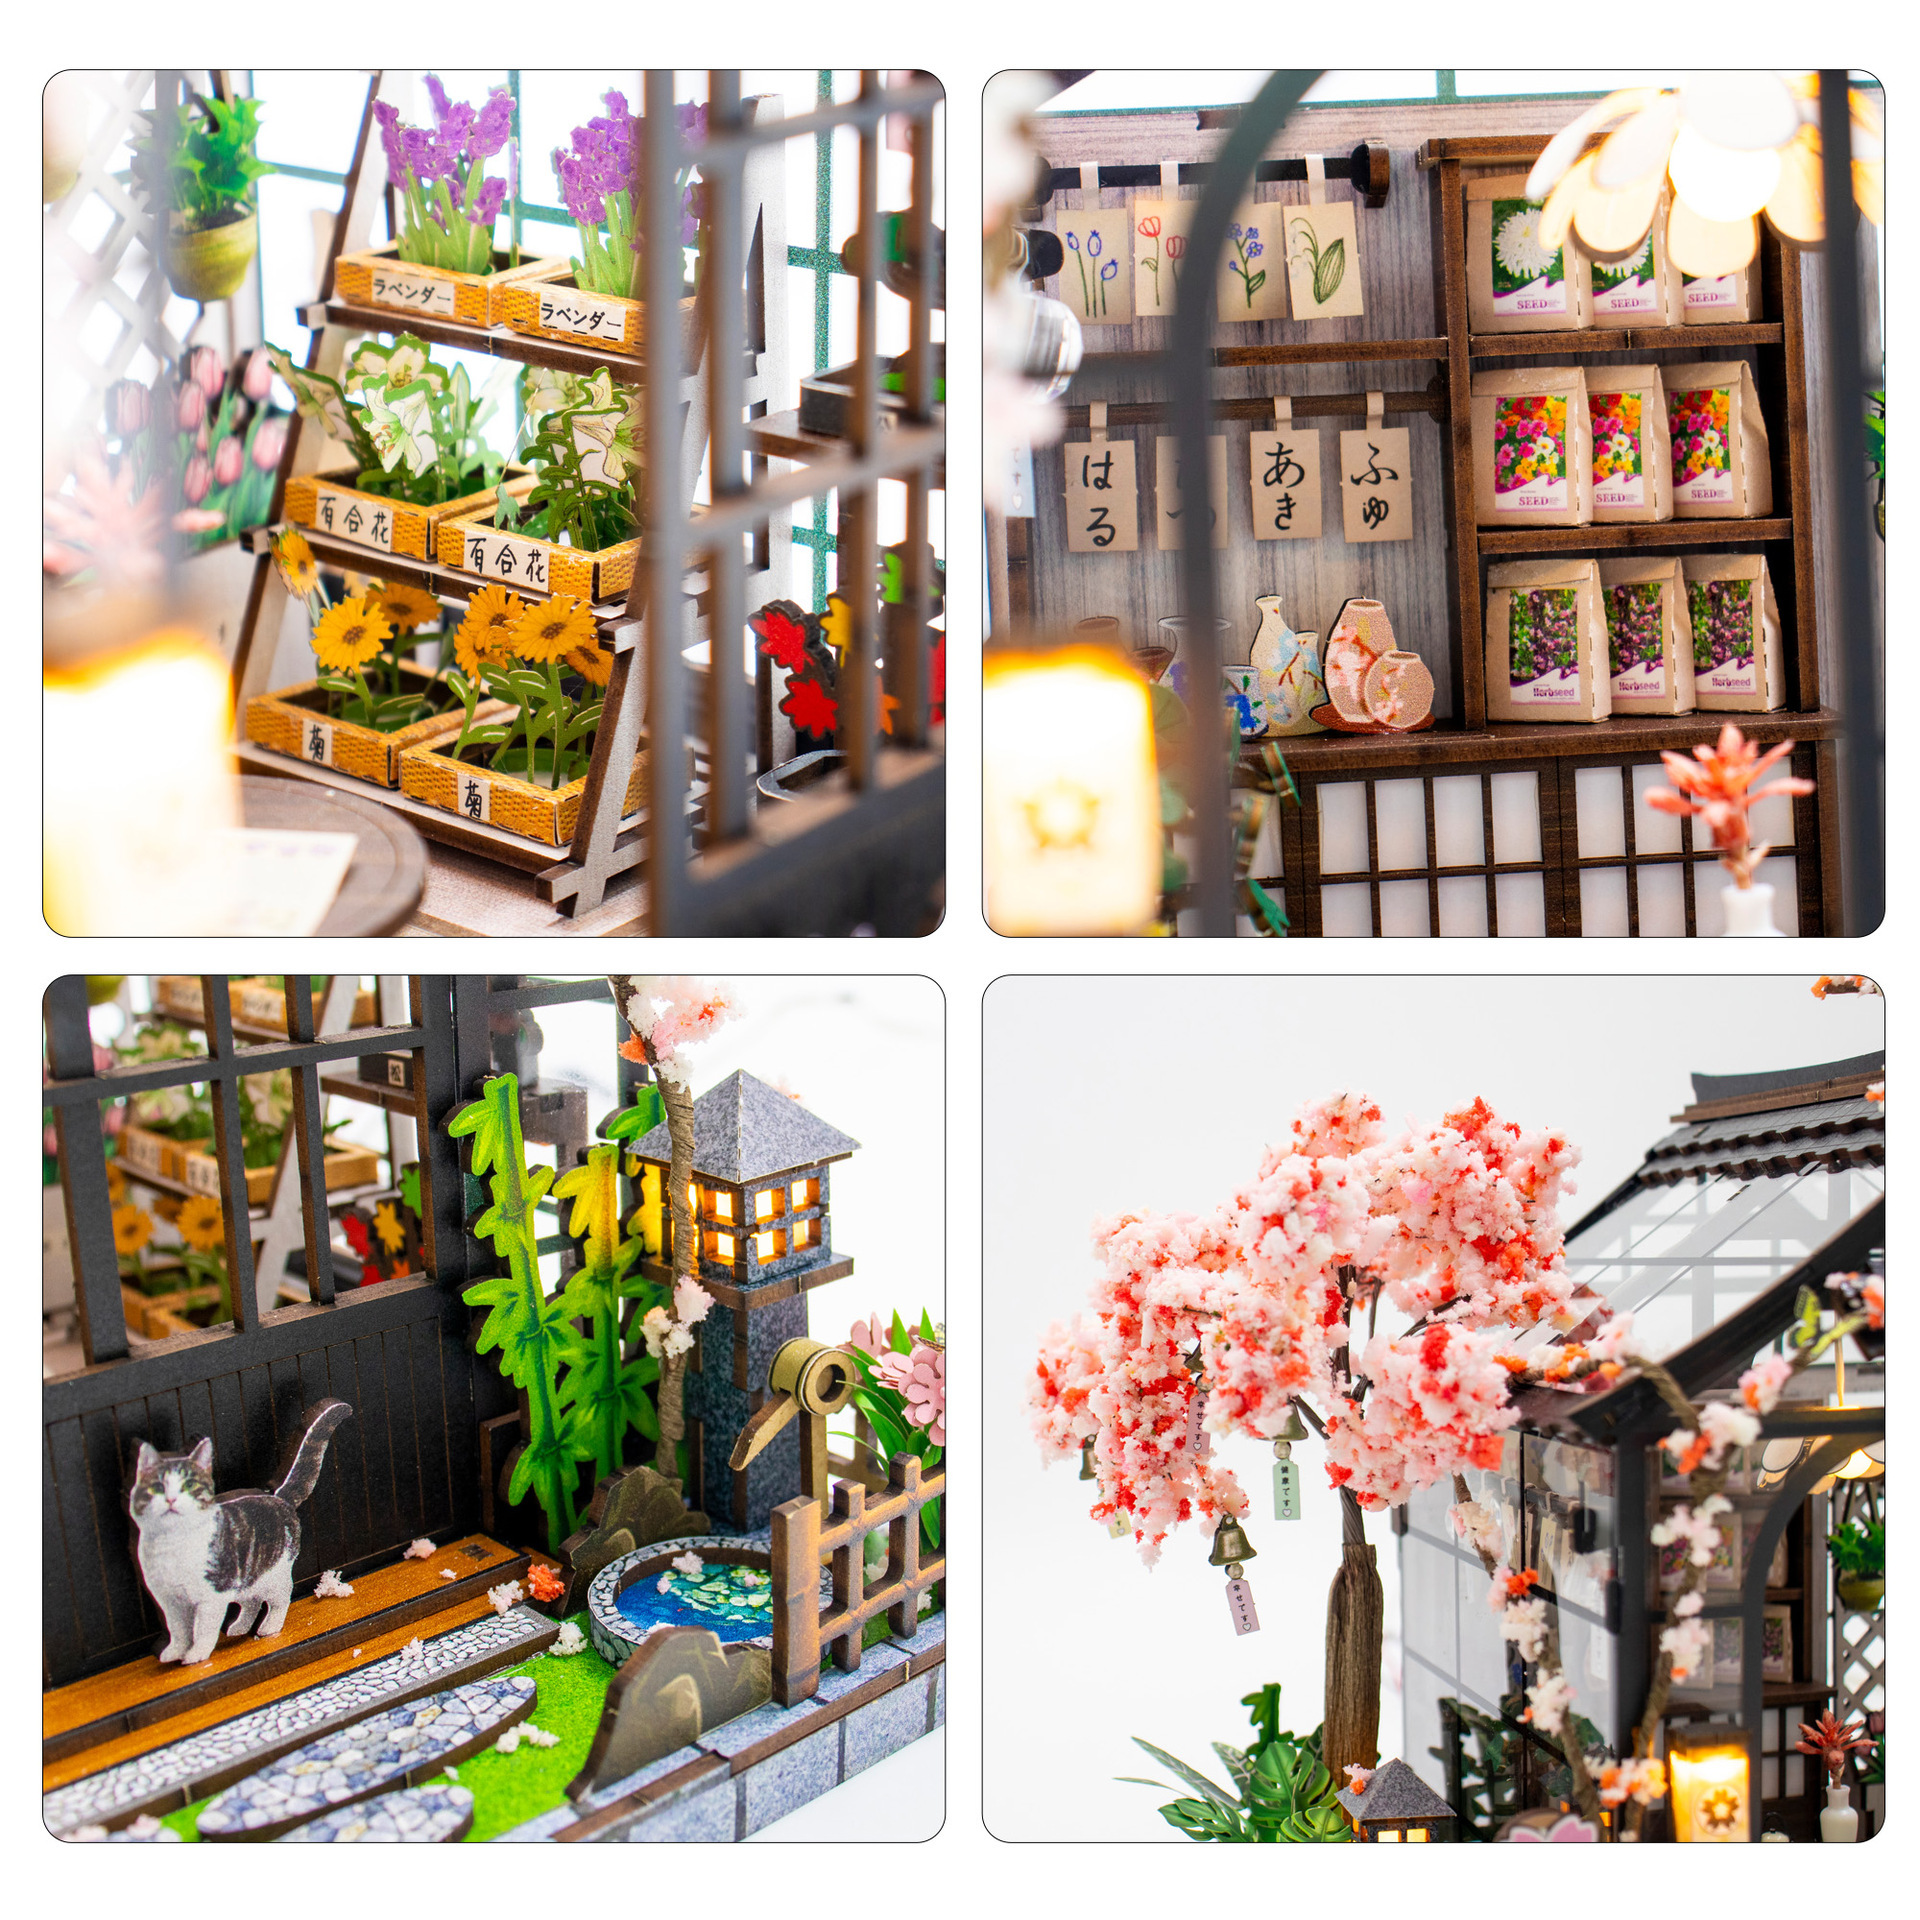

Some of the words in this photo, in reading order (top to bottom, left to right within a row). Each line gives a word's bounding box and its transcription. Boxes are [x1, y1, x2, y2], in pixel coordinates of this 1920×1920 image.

[373, 278, 452, 304] ラベンダー
[1688, 293, 1719, 303] SEED
[1517, 299, 1548, 309] SEED
[1610, 298, 1640, 309] SEED
[540, 302, 623, 331] ラベンダー
[1263, 442, 1305, 531] あき
[1350, 442, 1399, 530] ふゆ
[1691, 489, 1717, 499] SEED
[1082, 451, 1116, 547] はる
[1518, 496, 1549, 506] SEED
[1595, 493, 1626, 503] SEED
[318, 497, 389, 544] 百合花
[467, 537, 546, 583] 百合花
[1618, 681, 1660, 691] Herbseed
[1712, 677, 1751, 687] Herbseed
[1533, 688, 1575, 697] Herbseed
[309, 724, 325, 762] 菊
[464, 780, 482, 819] 菊
